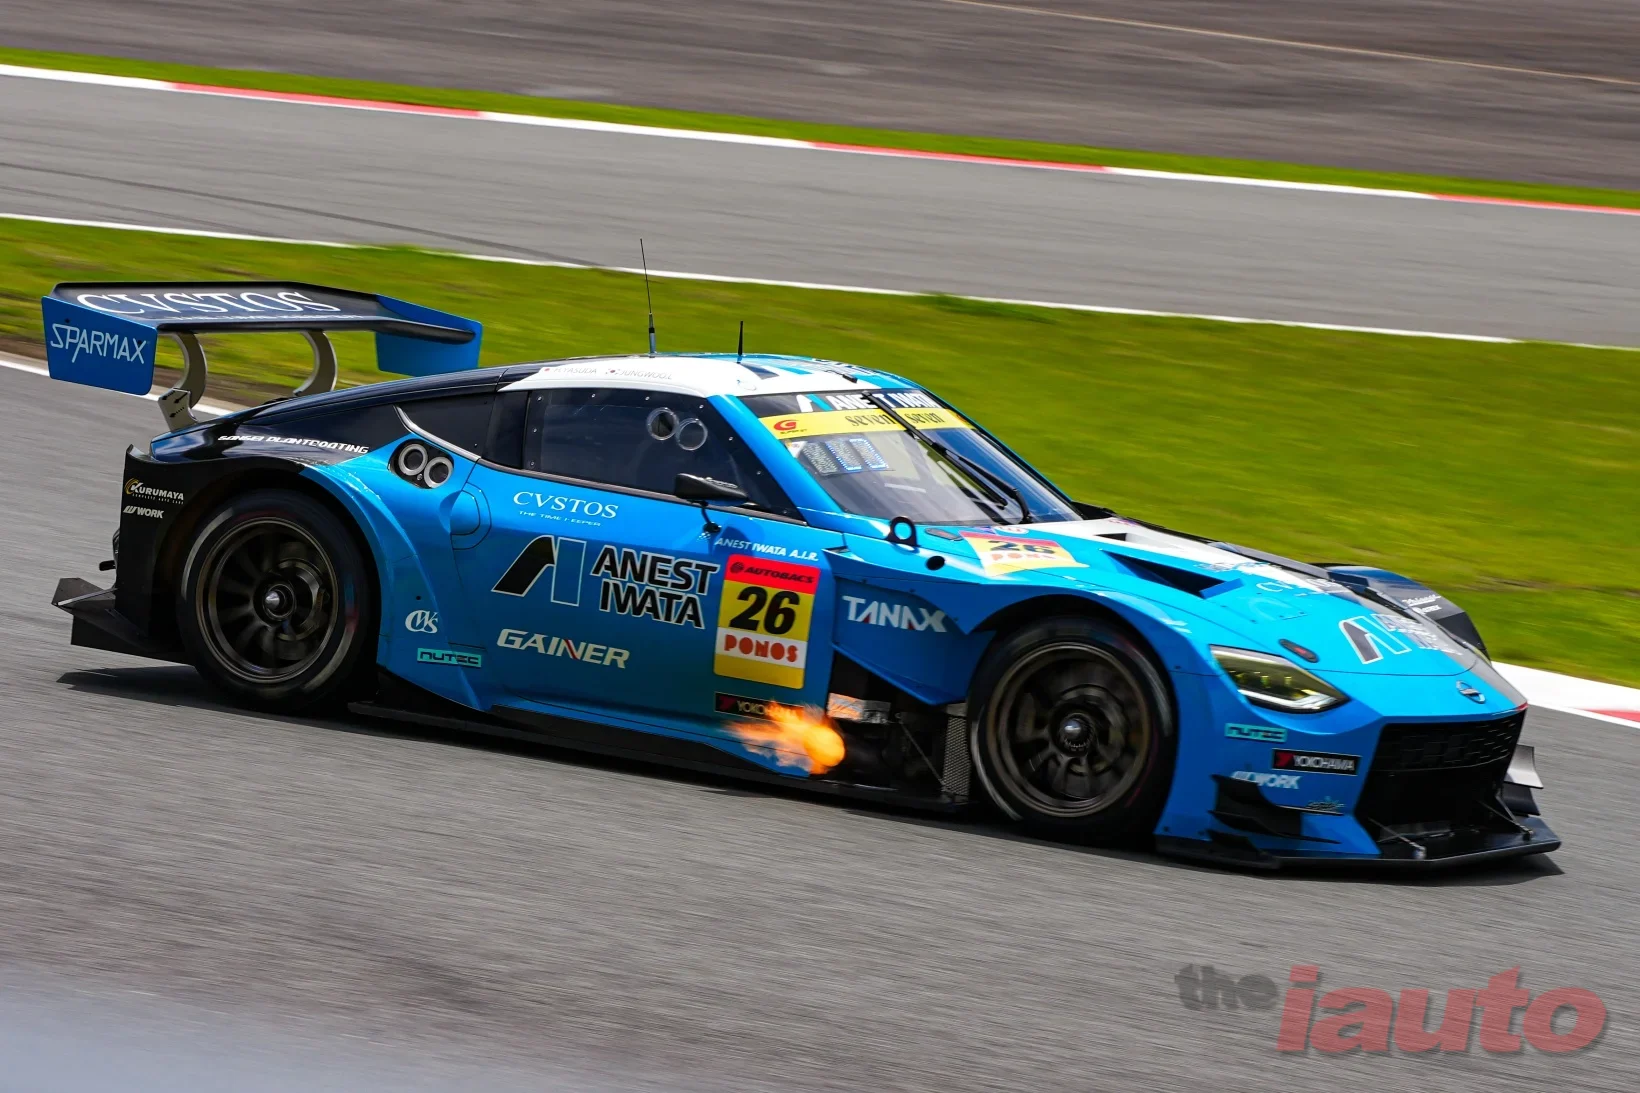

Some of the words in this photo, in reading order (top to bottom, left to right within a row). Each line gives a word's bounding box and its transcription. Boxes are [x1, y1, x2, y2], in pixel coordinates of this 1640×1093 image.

[76, 291, 341, 315] CVSTOS
[50, 323, 147, 365] SPARMAX
[826, 393, 897, 411] ANET
[130, 482, 185, 501] KURUMAYA
[137, 506, 164, 519] WORK
[513, 491, 619, 519] CVSTOS
[540, 513, 562, 521] TIME
[714, 537, 752, 550] ANEST
[752, 542, 787, 556] IWATA
[988, 540, 1056, 554] 26
[590, 545, 720, 595] ANEST
[743, 566, 815, 584] AUTOBACS
[600, 580, 705, 630] IWATA
[729, 586, 800, 635] 26
[841, 595, 948, 633] TANAX
[496, 628, 630, 669] GAINER
[724, 633, 799, 663] PONOS
[1293, 754, 1355, 771] YOKOHAMA
